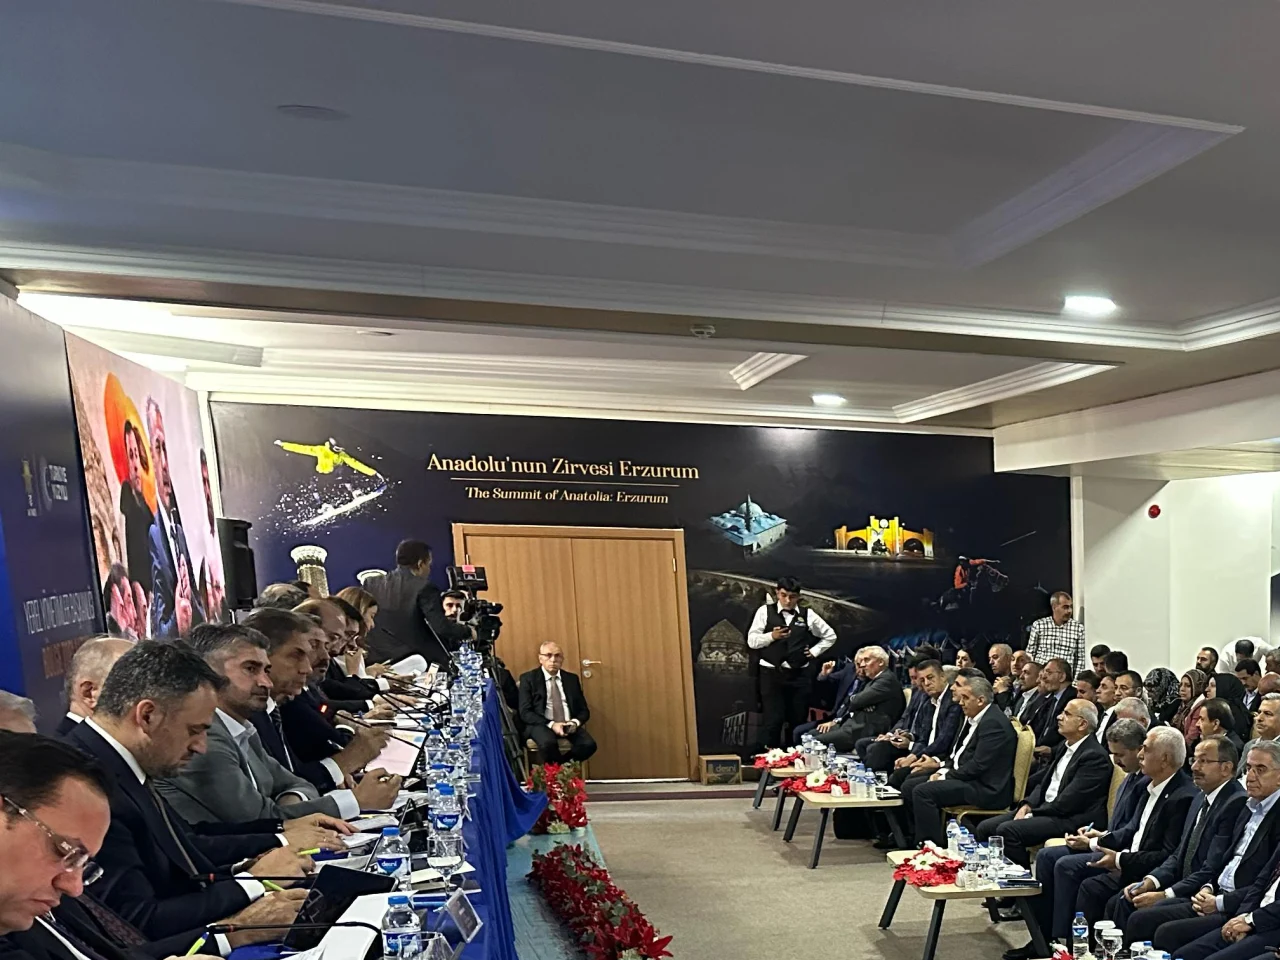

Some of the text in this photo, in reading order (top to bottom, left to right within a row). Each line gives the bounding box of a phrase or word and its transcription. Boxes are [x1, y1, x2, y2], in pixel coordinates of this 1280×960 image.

[427, 453, 700, 480] Anadolu'nun Zirvesi Erzurum
[465, 486, 669, 504] The Summit of Anatolia: Erzurum
